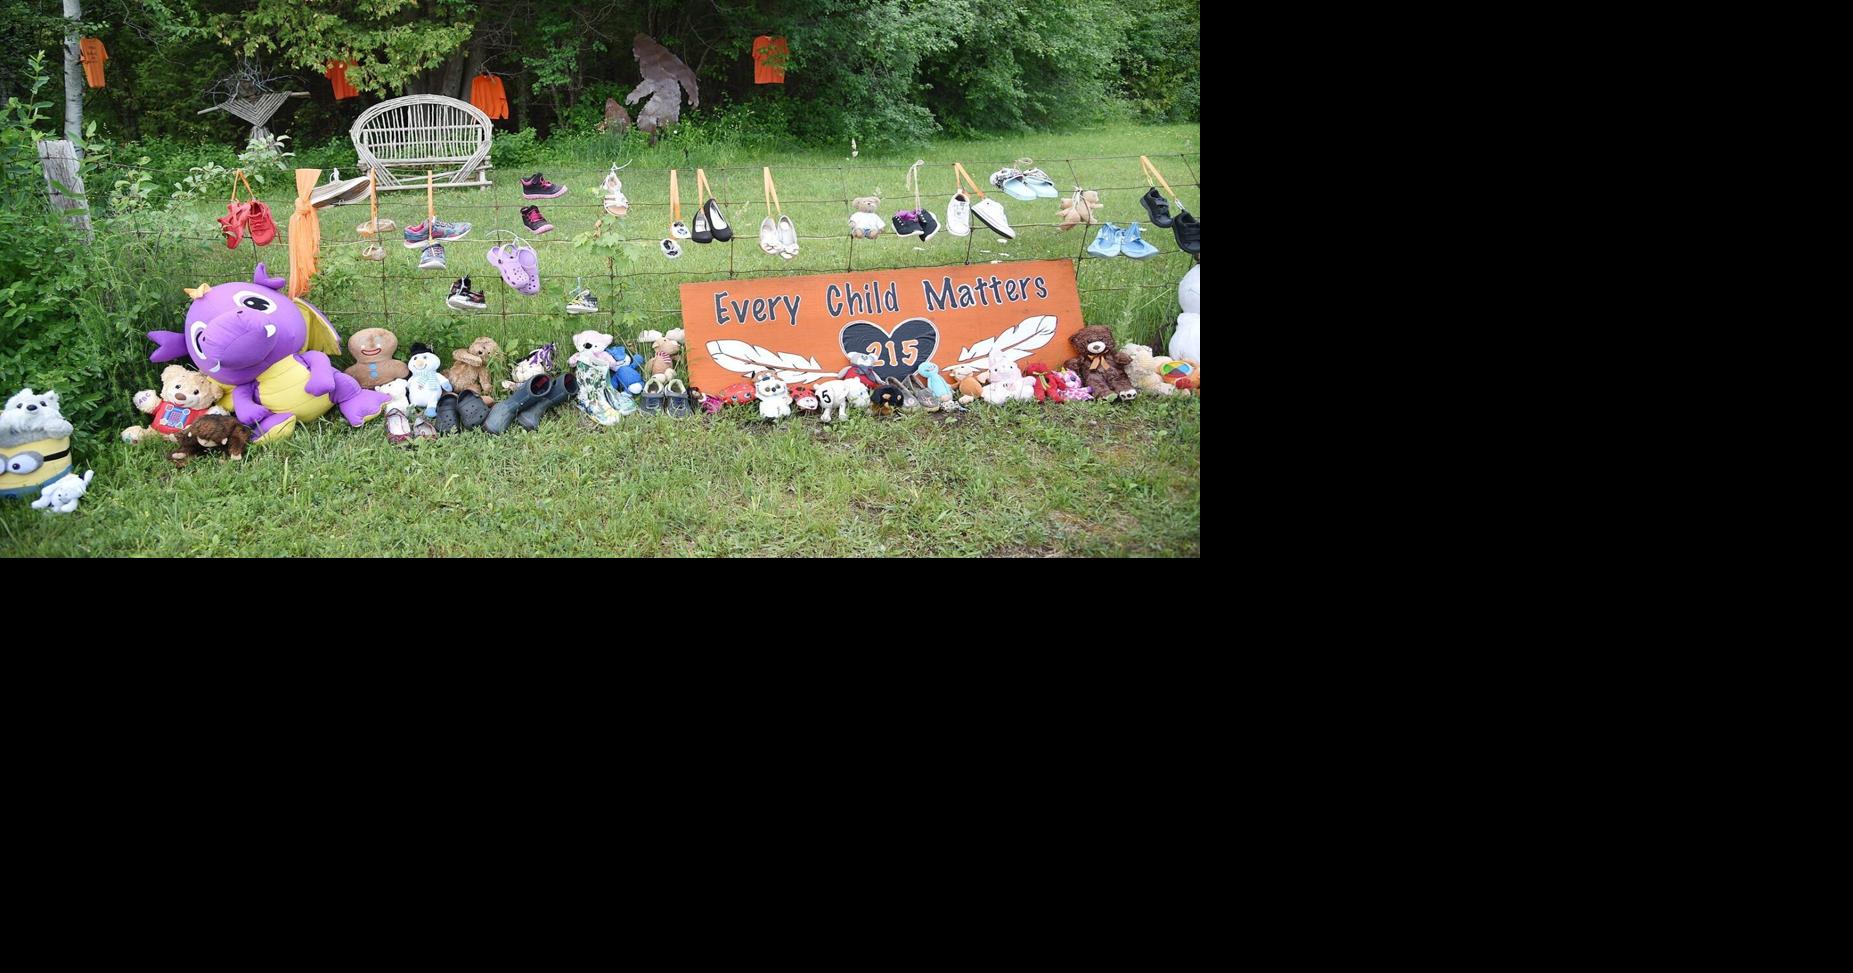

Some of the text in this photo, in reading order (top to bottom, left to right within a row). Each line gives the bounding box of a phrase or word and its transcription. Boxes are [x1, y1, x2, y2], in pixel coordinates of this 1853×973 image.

[714, 275, 1048, 325] Every Child Matters
[866, 339, 919, 367] 215
[138, 392, 151, 405] ABC
[821, 389, 831, 404] 5
